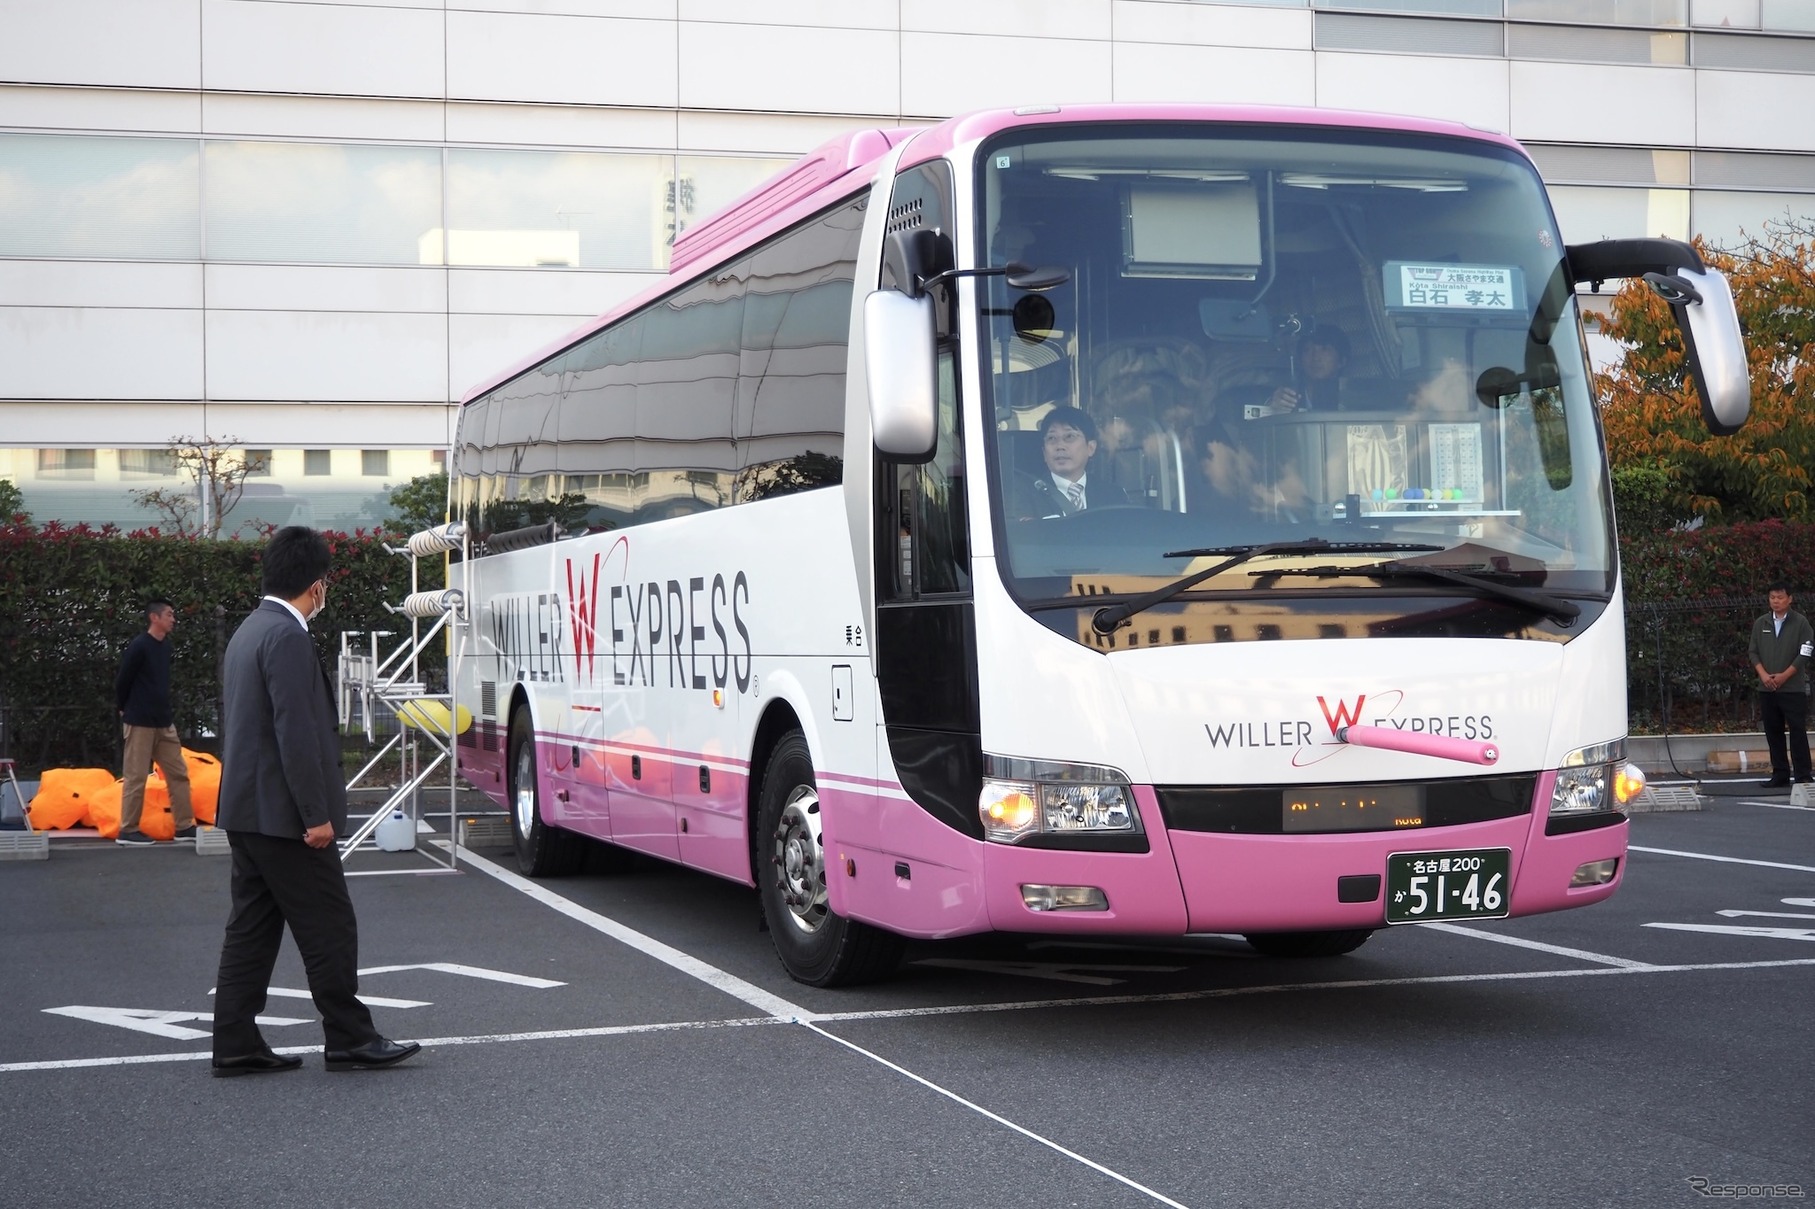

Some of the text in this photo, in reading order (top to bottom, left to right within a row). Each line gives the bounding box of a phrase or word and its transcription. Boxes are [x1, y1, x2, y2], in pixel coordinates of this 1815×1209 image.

[1432, 283, 1469, 291] Shiraishi
[1447, 273, 1505, 284] 大阪さやま交通
[1409, 287, 1506, 307] 白石 孝太
[491, 592, 564, 683] WILLER
[611, 570, 752, 695] EXPRESS
[1204, 721, 1313, 749] WILLER
[1394, 872, 1502, 914] か 51-46
